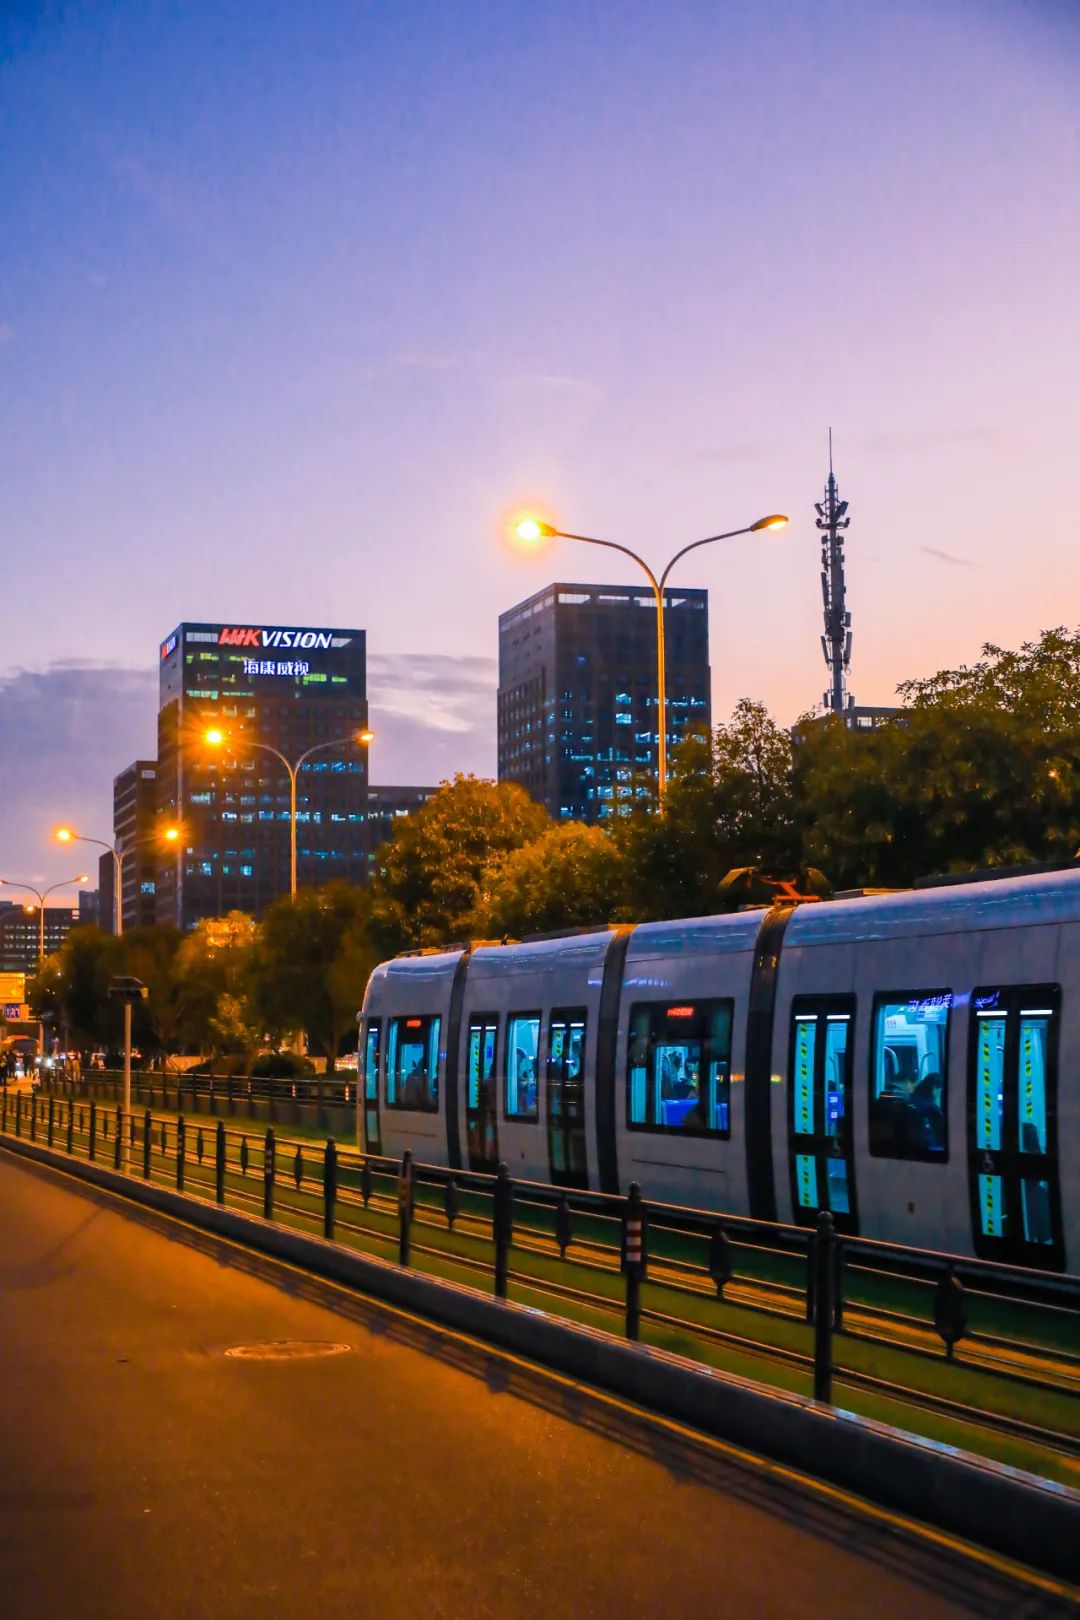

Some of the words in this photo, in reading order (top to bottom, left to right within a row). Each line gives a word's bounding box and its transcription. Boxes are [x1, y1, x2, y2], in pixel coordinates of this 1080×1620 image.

[218, 627, 333, 649] HIKVISION
[243, 660, 309, 676] 海康威视
